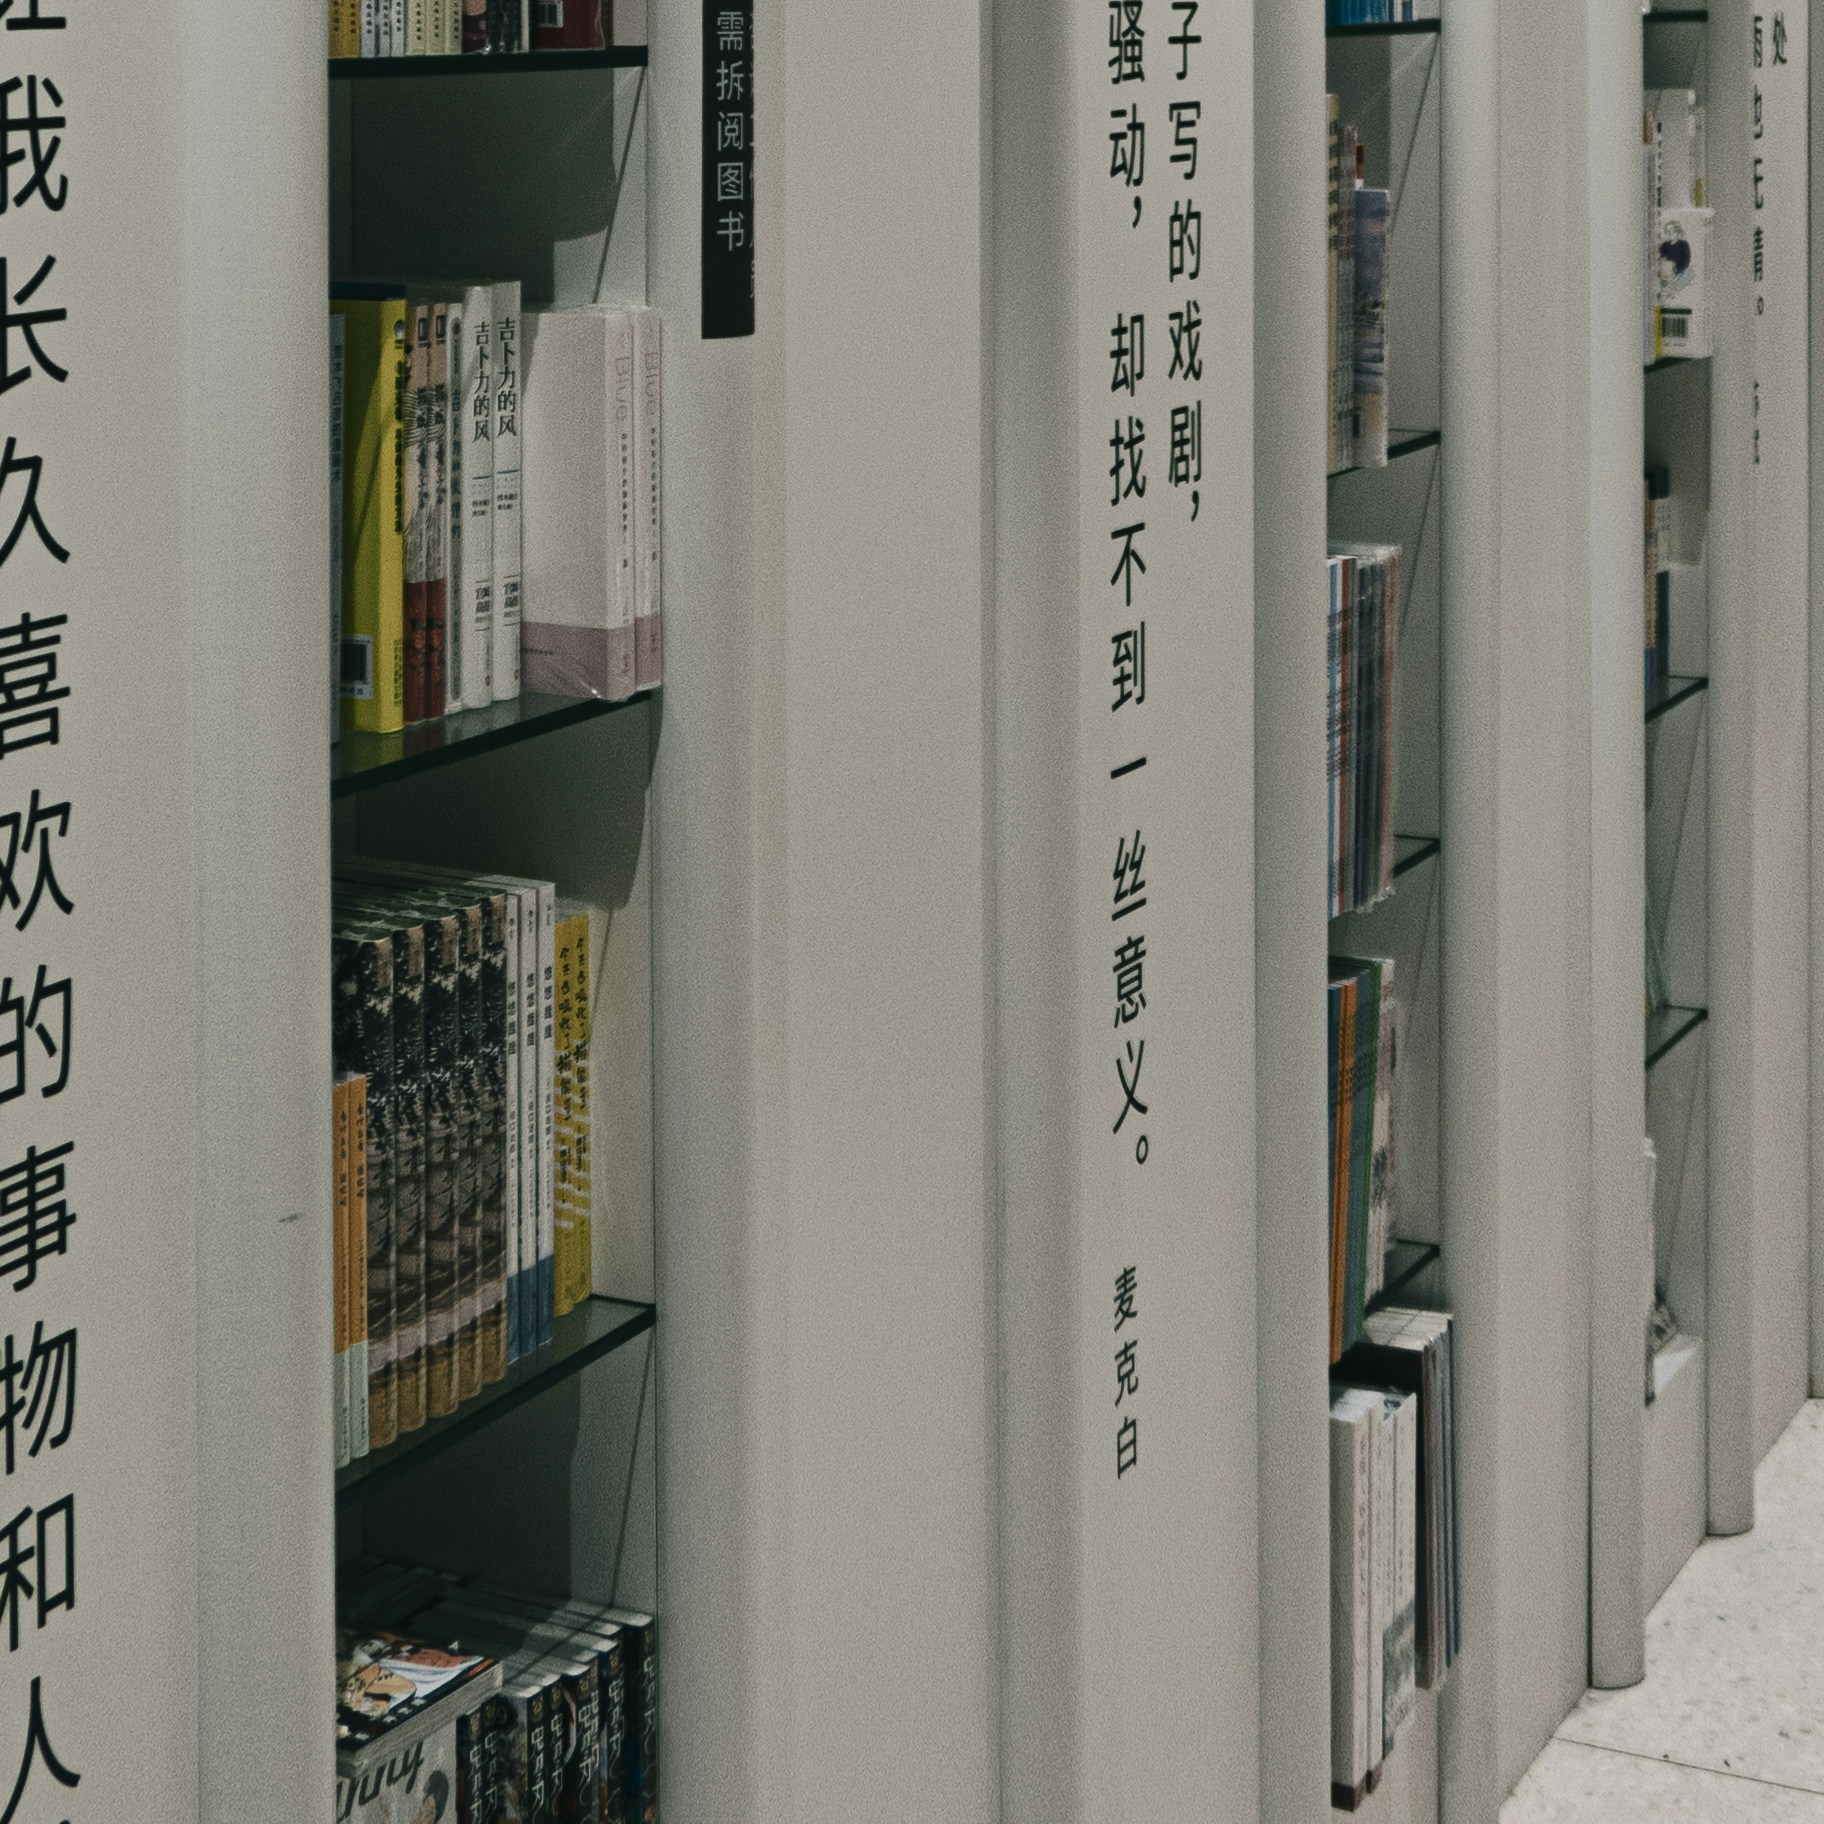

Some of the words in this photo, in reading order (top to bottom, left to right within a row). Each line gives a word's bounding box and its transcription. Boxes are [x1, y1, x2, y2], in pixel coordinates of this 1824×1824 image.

[472, 321, 492, 443] 吉卜力的风
[496, 316, 519, 439] 吉卜力的风
[1113, 1265, 1140, 1481] 麦克白
